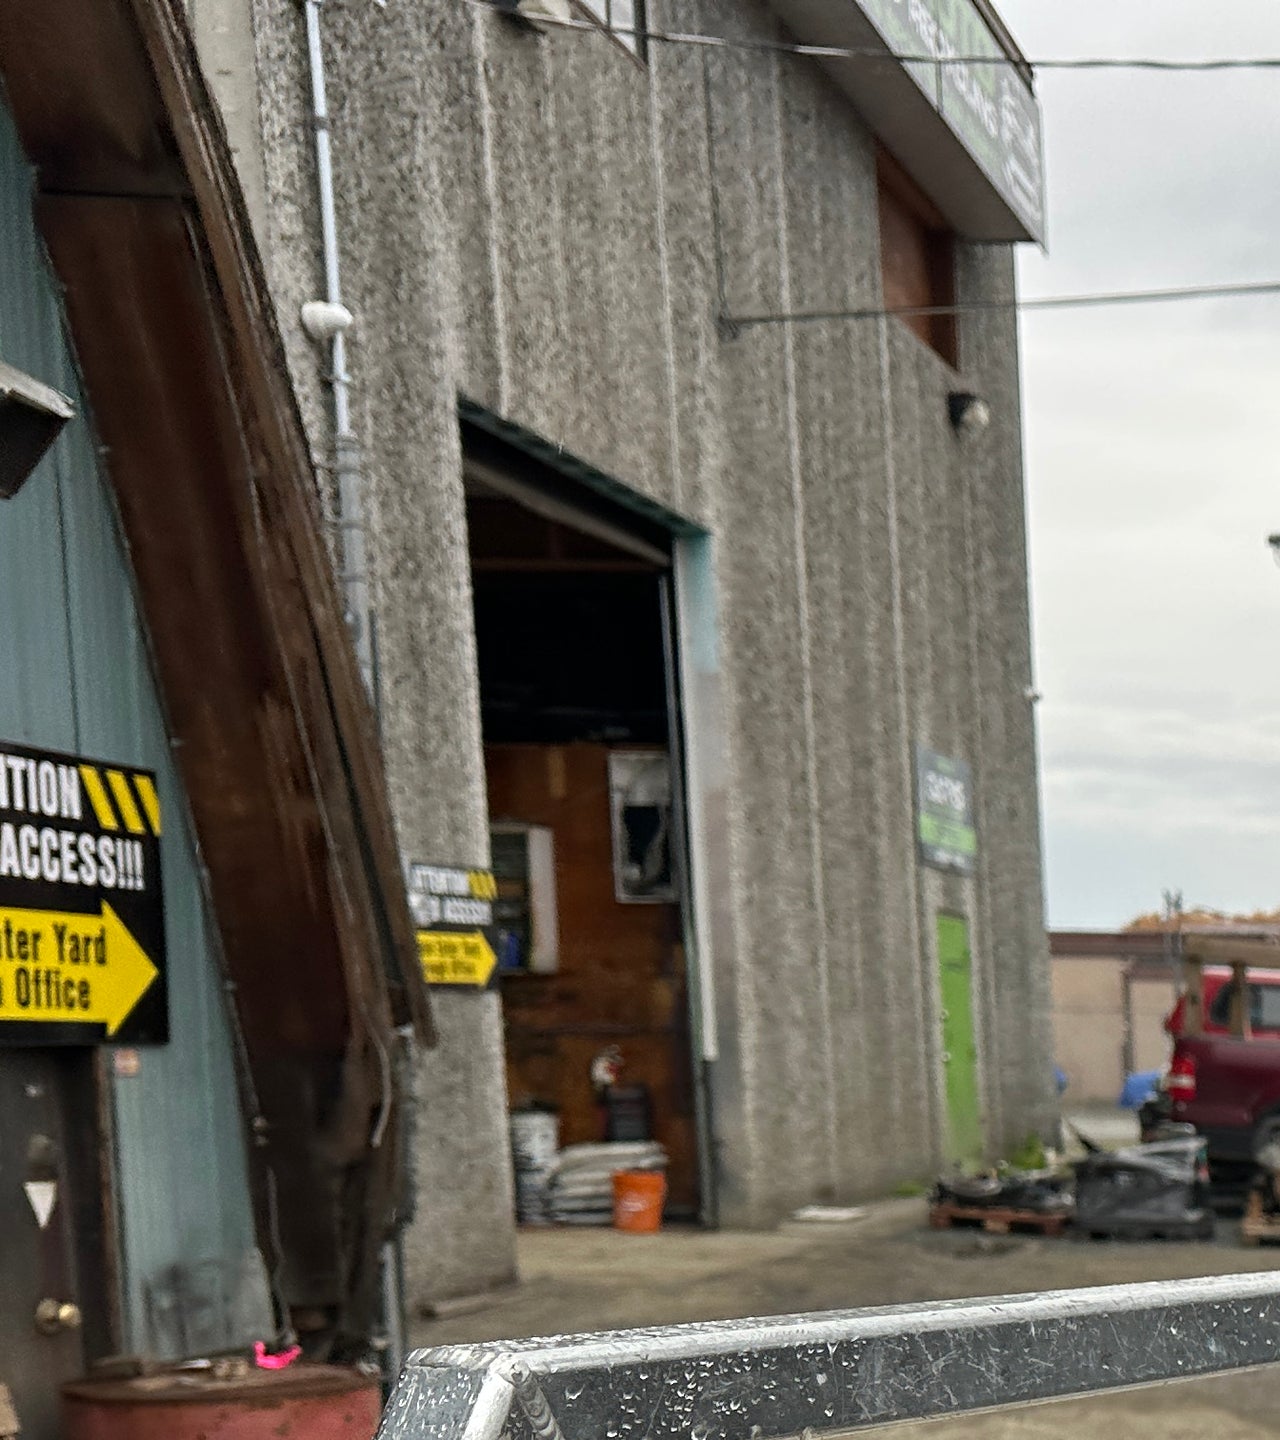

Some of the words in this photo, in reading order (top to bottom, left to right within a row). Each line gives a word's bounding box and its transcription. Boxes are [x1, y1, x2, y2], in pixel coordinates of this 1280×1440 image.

[0, 823, 145, 890] ACCESS!!!
[0, 917, 42, 962] ter
[53, 922, 107, 966] Yard
[14, 967, 91, 1011] Office
